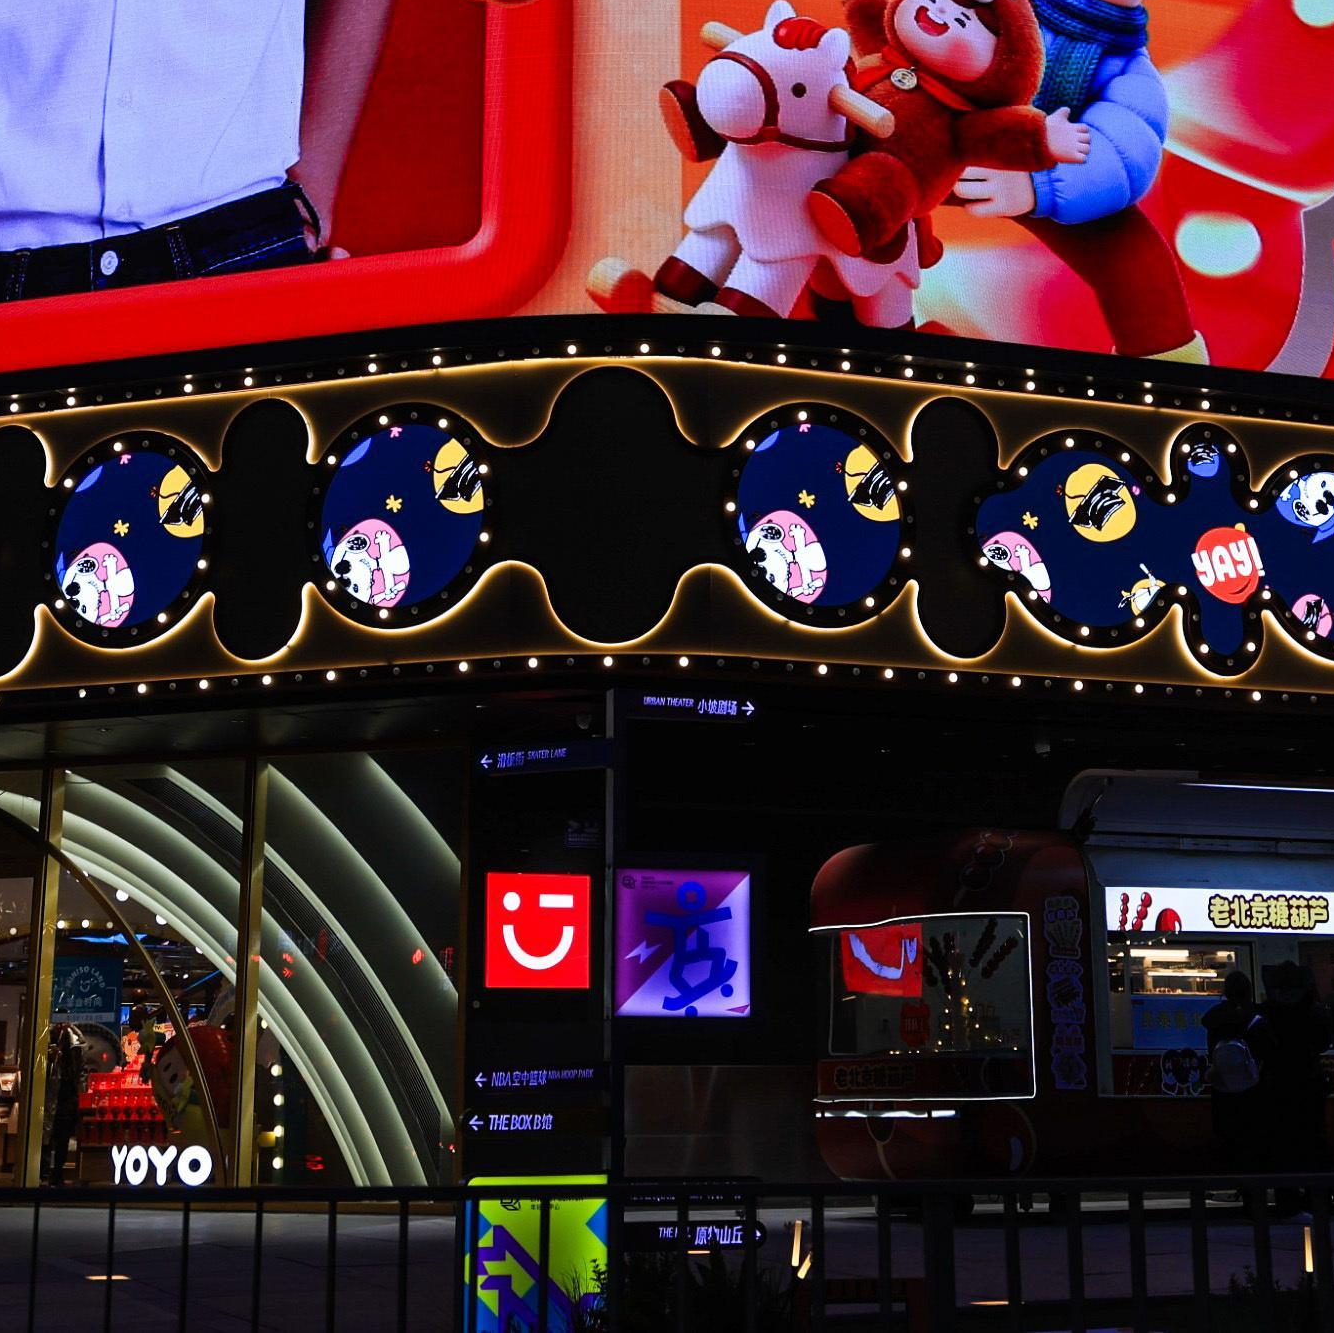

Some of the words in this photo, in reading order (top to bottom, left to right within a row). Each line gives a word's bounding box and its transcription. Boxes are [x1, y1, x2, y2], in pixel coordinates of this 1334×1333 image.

[1190, 535, 1266, 590] YAY!
[666, 696, 694, 708] THEATER
[526, 749, 549, 761] SKATER
[550, 747, 568, 759] LANE
[1208, 892, 1330, 931] 老北京糖葫芦
[489, 1114, 510, 1131] THE
[510, 1114, 533, 1131] BOX
[111, 1144, 213, 1187] YOYO
